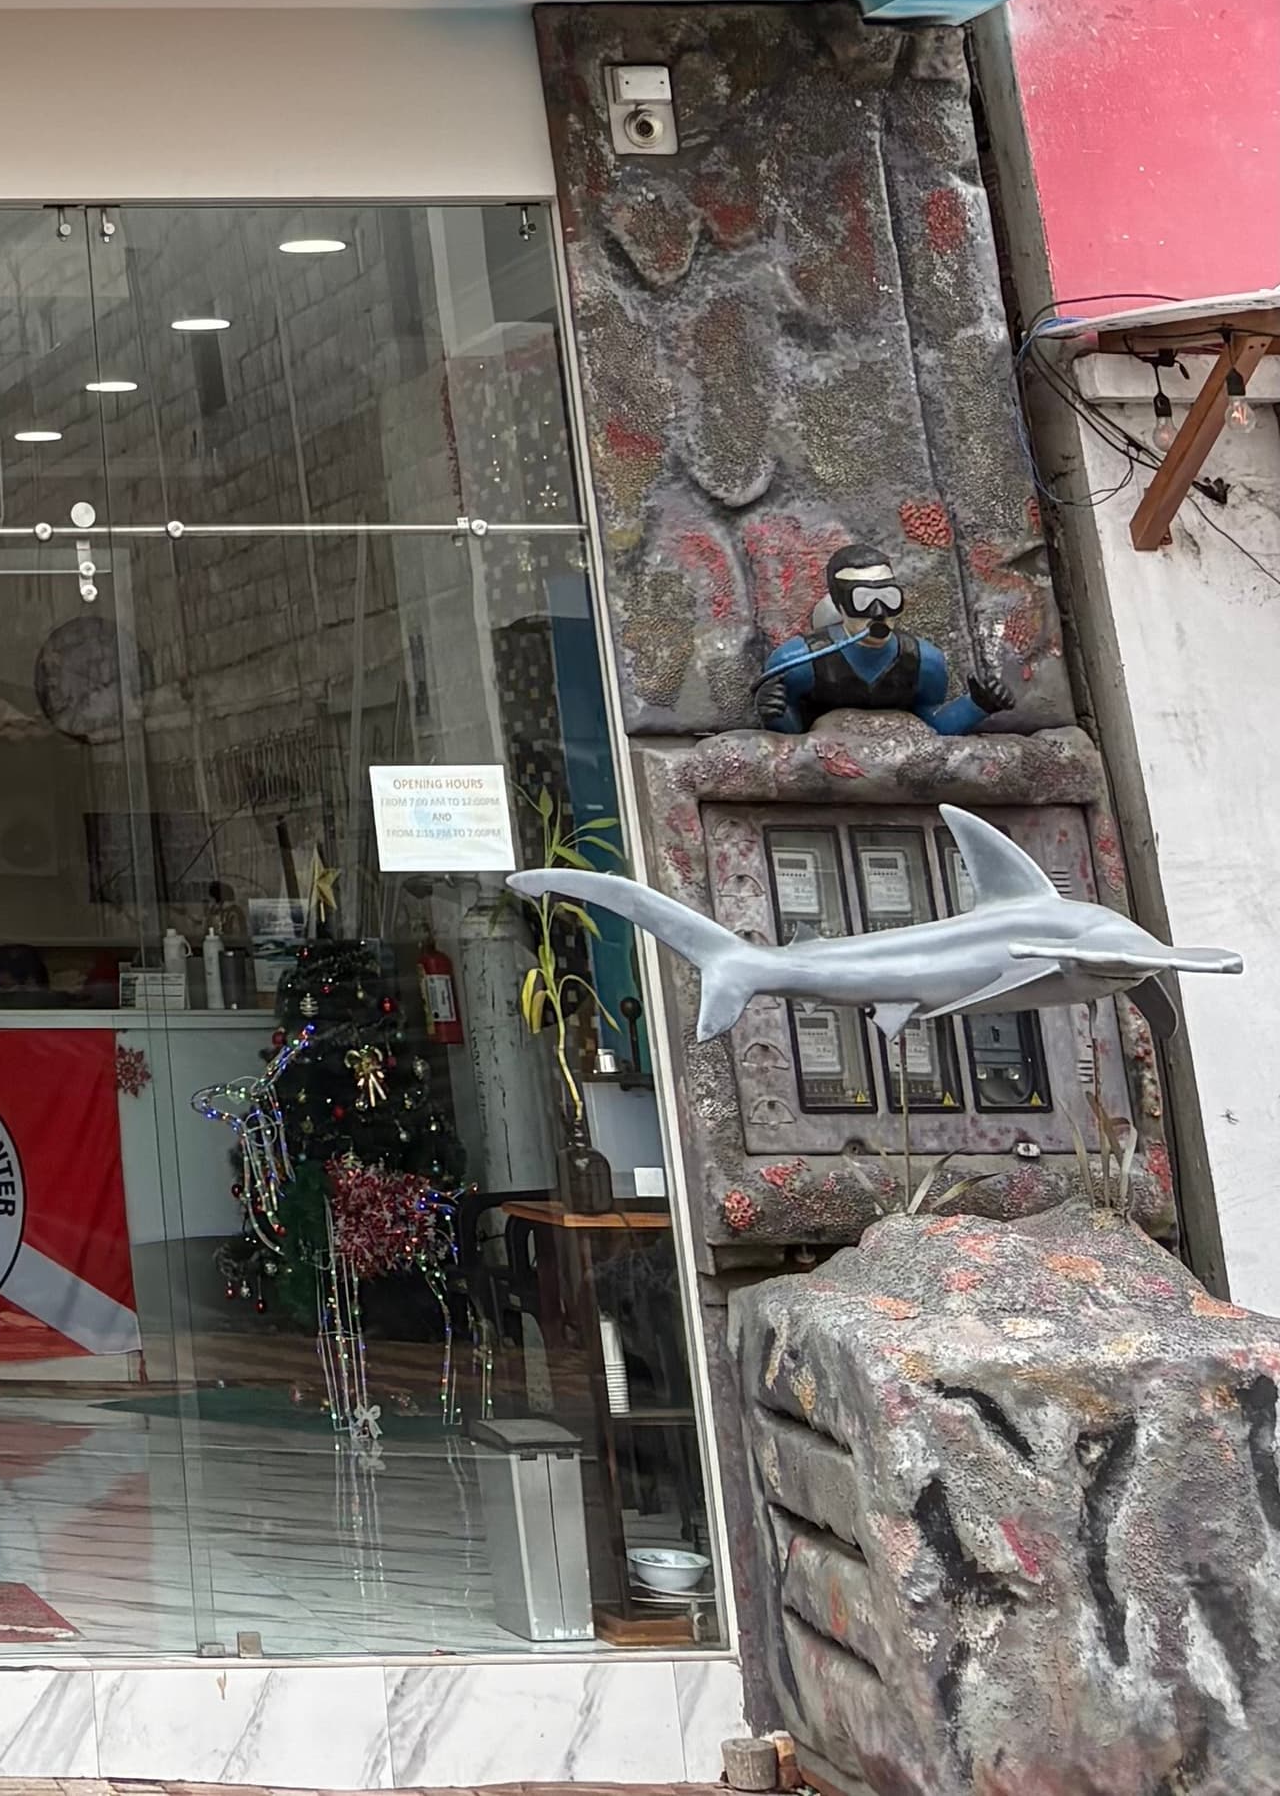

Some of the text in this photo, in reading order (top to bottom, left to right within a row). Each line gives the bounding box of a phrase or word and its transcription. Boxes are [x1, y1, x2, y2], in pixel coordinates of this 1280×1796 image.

[392, 778, 484, 790] OPENING HOURS
[448, 797, 460, 807] TO
[431, 812, 452, 822] AND
[453, 829, 466, 838] TO
